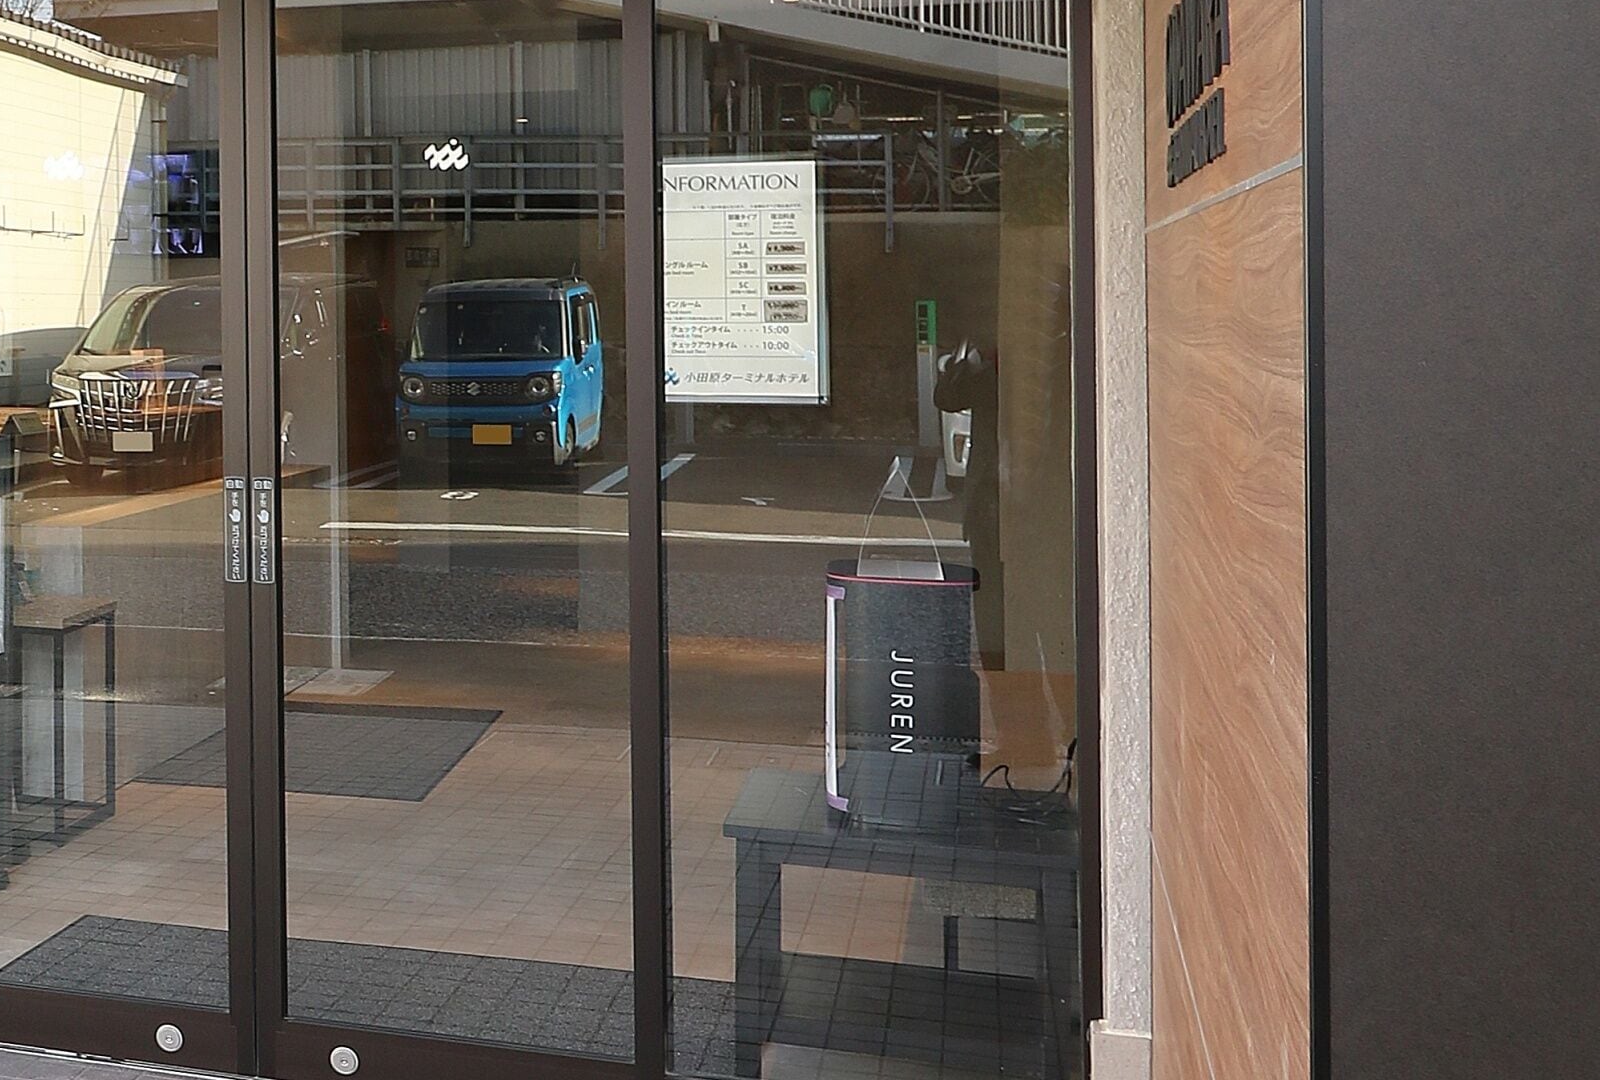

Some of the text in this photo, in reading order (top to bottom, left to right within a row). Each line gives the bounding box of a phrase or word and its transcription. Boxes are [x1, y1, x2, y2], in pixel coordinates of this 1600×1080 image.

[671, 325, 789, 334] チェックインタイム 15:00
[671, 341, 789, 350] チェックアウトタイム 10:00
[684, 372, 810, 384] 小田原ターミナルホテル
[890, 650, 914, 755] JUREN
